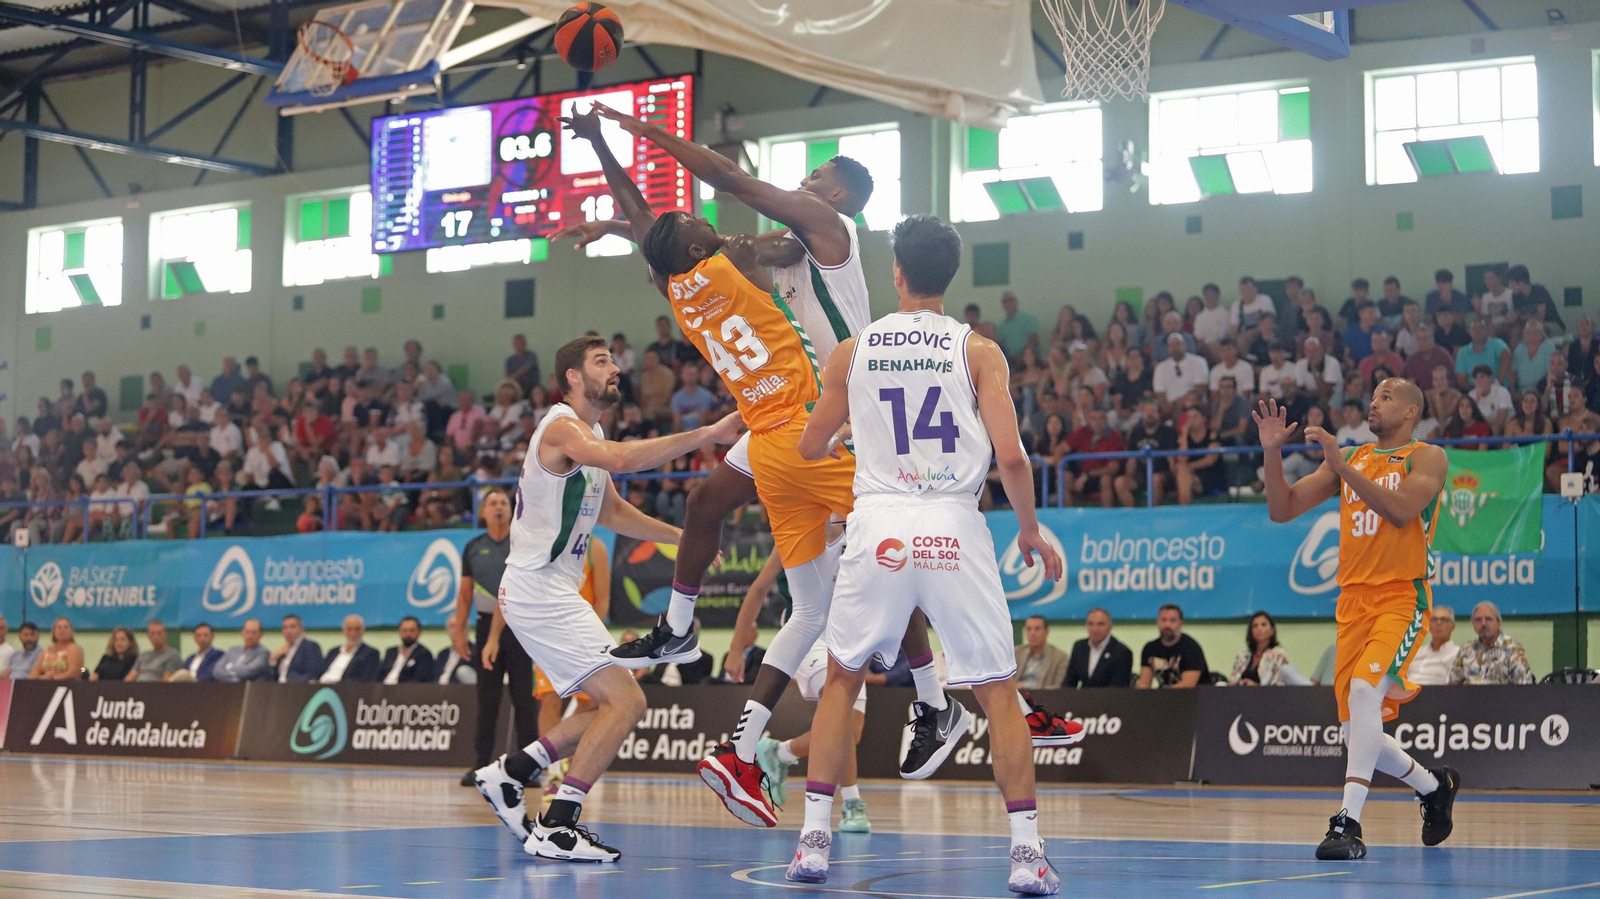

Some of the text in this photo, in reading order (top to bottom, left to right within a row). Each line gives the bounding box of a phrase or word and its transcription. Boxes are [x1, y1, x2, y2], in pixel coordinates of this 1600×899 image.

[440, 210, 473, 238] 17
[701, 314, 773, 383] 43
[868, 358, 953, 374] BENAHAVÍS
[879, 386, 960, 455] 14
[896, 466, 959, 483] Andalucía
[1352, 509, 1378, 538] 30
[912, 536, 960, 549] COSTA
[1081, 531, 1225, 564] baloncesto
[912, 550, 960, 561] DEL SOL
[913, 560, 960, 571] MÁLAGA
[68, 565, 127, 587] BASKET
[264, 555, 364, 582] baloncesto
[65, 585, 156, 607] SOSTENIBLE
[90, 695, 145, 719] Junta
[356, 698, 460, 726] baloncesto
[637, 703, 695, 729] unta
[86, 720, 206, 748] de Andalucía
[618, 731, 650, 760] de
[1264, 725, 1321, 744] PONT
[1394, 713, 1536, 759] cajasur
[955, 742, 986, 765] de
[1303, 745, 1313, 756] DE
[1313, 745, 1343, 757] SEGUROS
